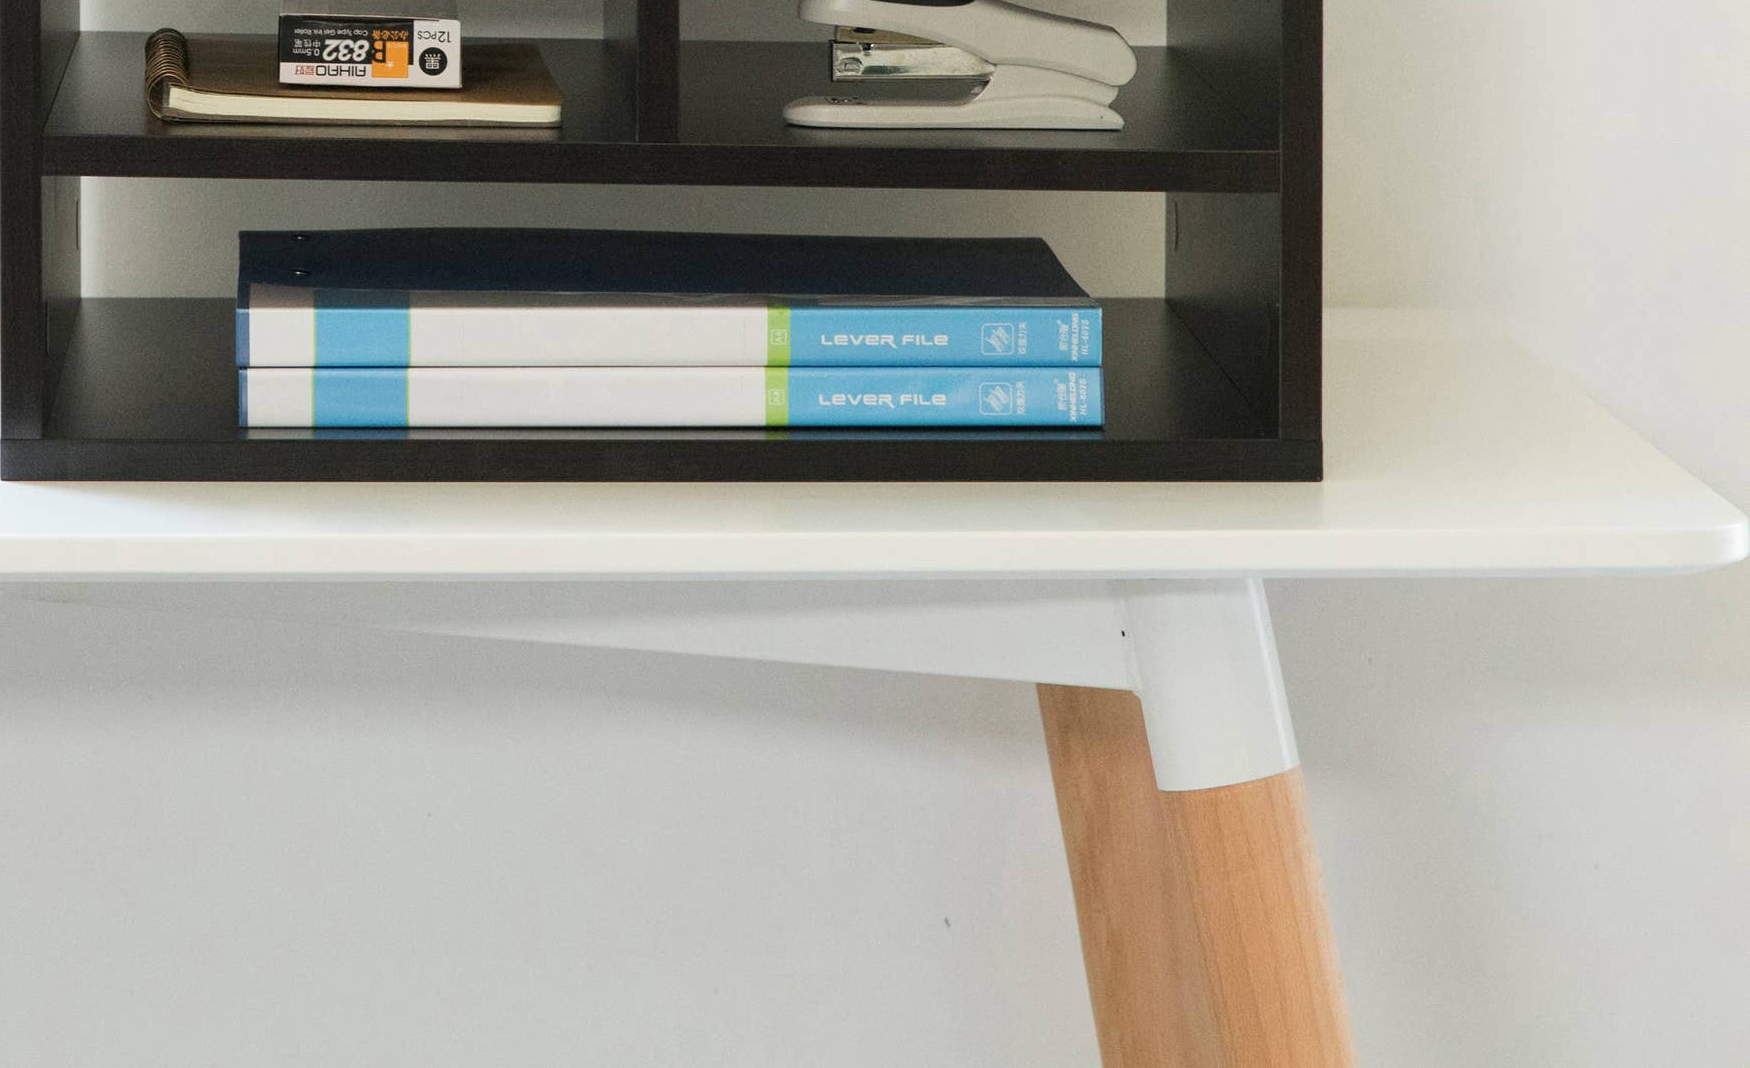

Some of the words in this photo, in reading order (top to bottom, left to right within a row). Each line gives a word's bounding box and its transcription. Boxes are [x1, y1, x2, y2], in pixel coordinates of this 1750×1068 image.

[292, 47, 321, 56] 0.5mm
[322, 39, 370, 61] 832
[424, 53, 441, 69] 黑
[316, 65, 367, 77] AIHAO
